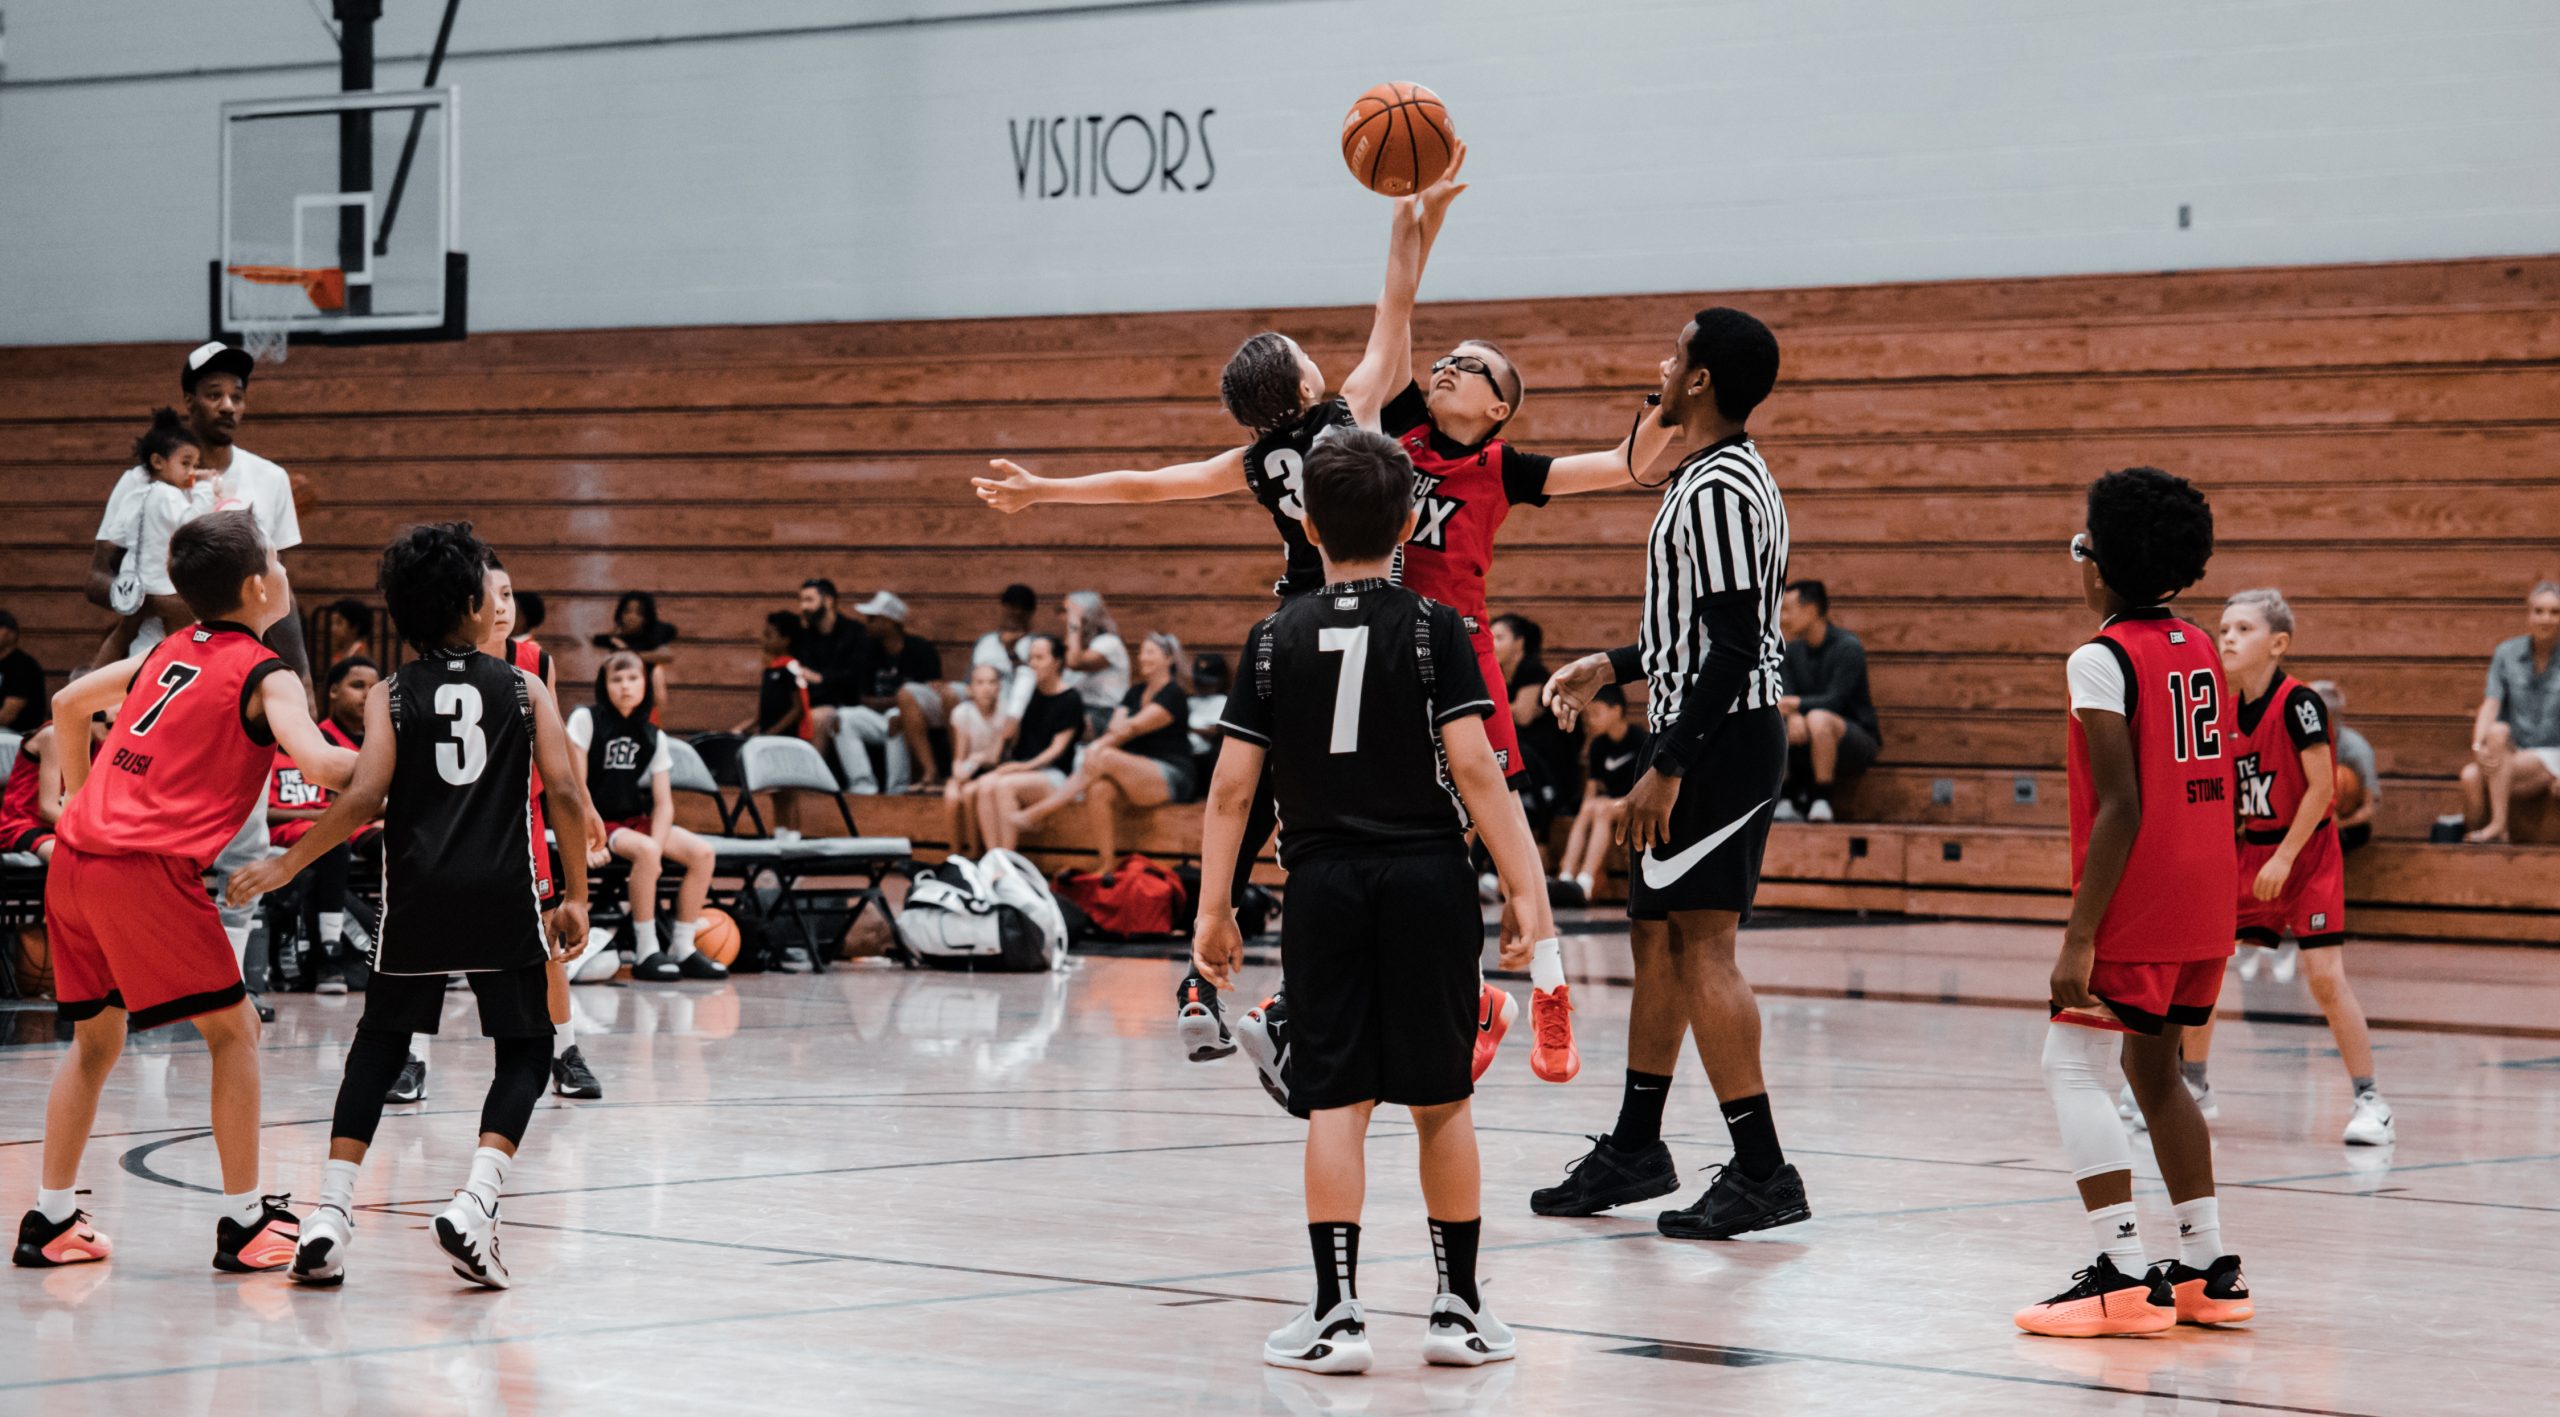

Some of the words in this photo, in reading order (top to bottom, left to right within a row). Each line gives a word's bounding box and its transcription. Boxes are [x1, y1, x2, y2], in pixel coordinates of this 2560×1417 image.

[1009, 108, 1216, 199] VISITORS
[130, 661, 202, 736] 7
[1319, 625, 1369, 754] 7
[2168, 668, 2221, 762] 12
[112, 748, 154, 776] BUSH
[434, 683, 487, 786] 3
[278, 769, 303, 784] THE
[2186, 777, 2225, 804] STONE
